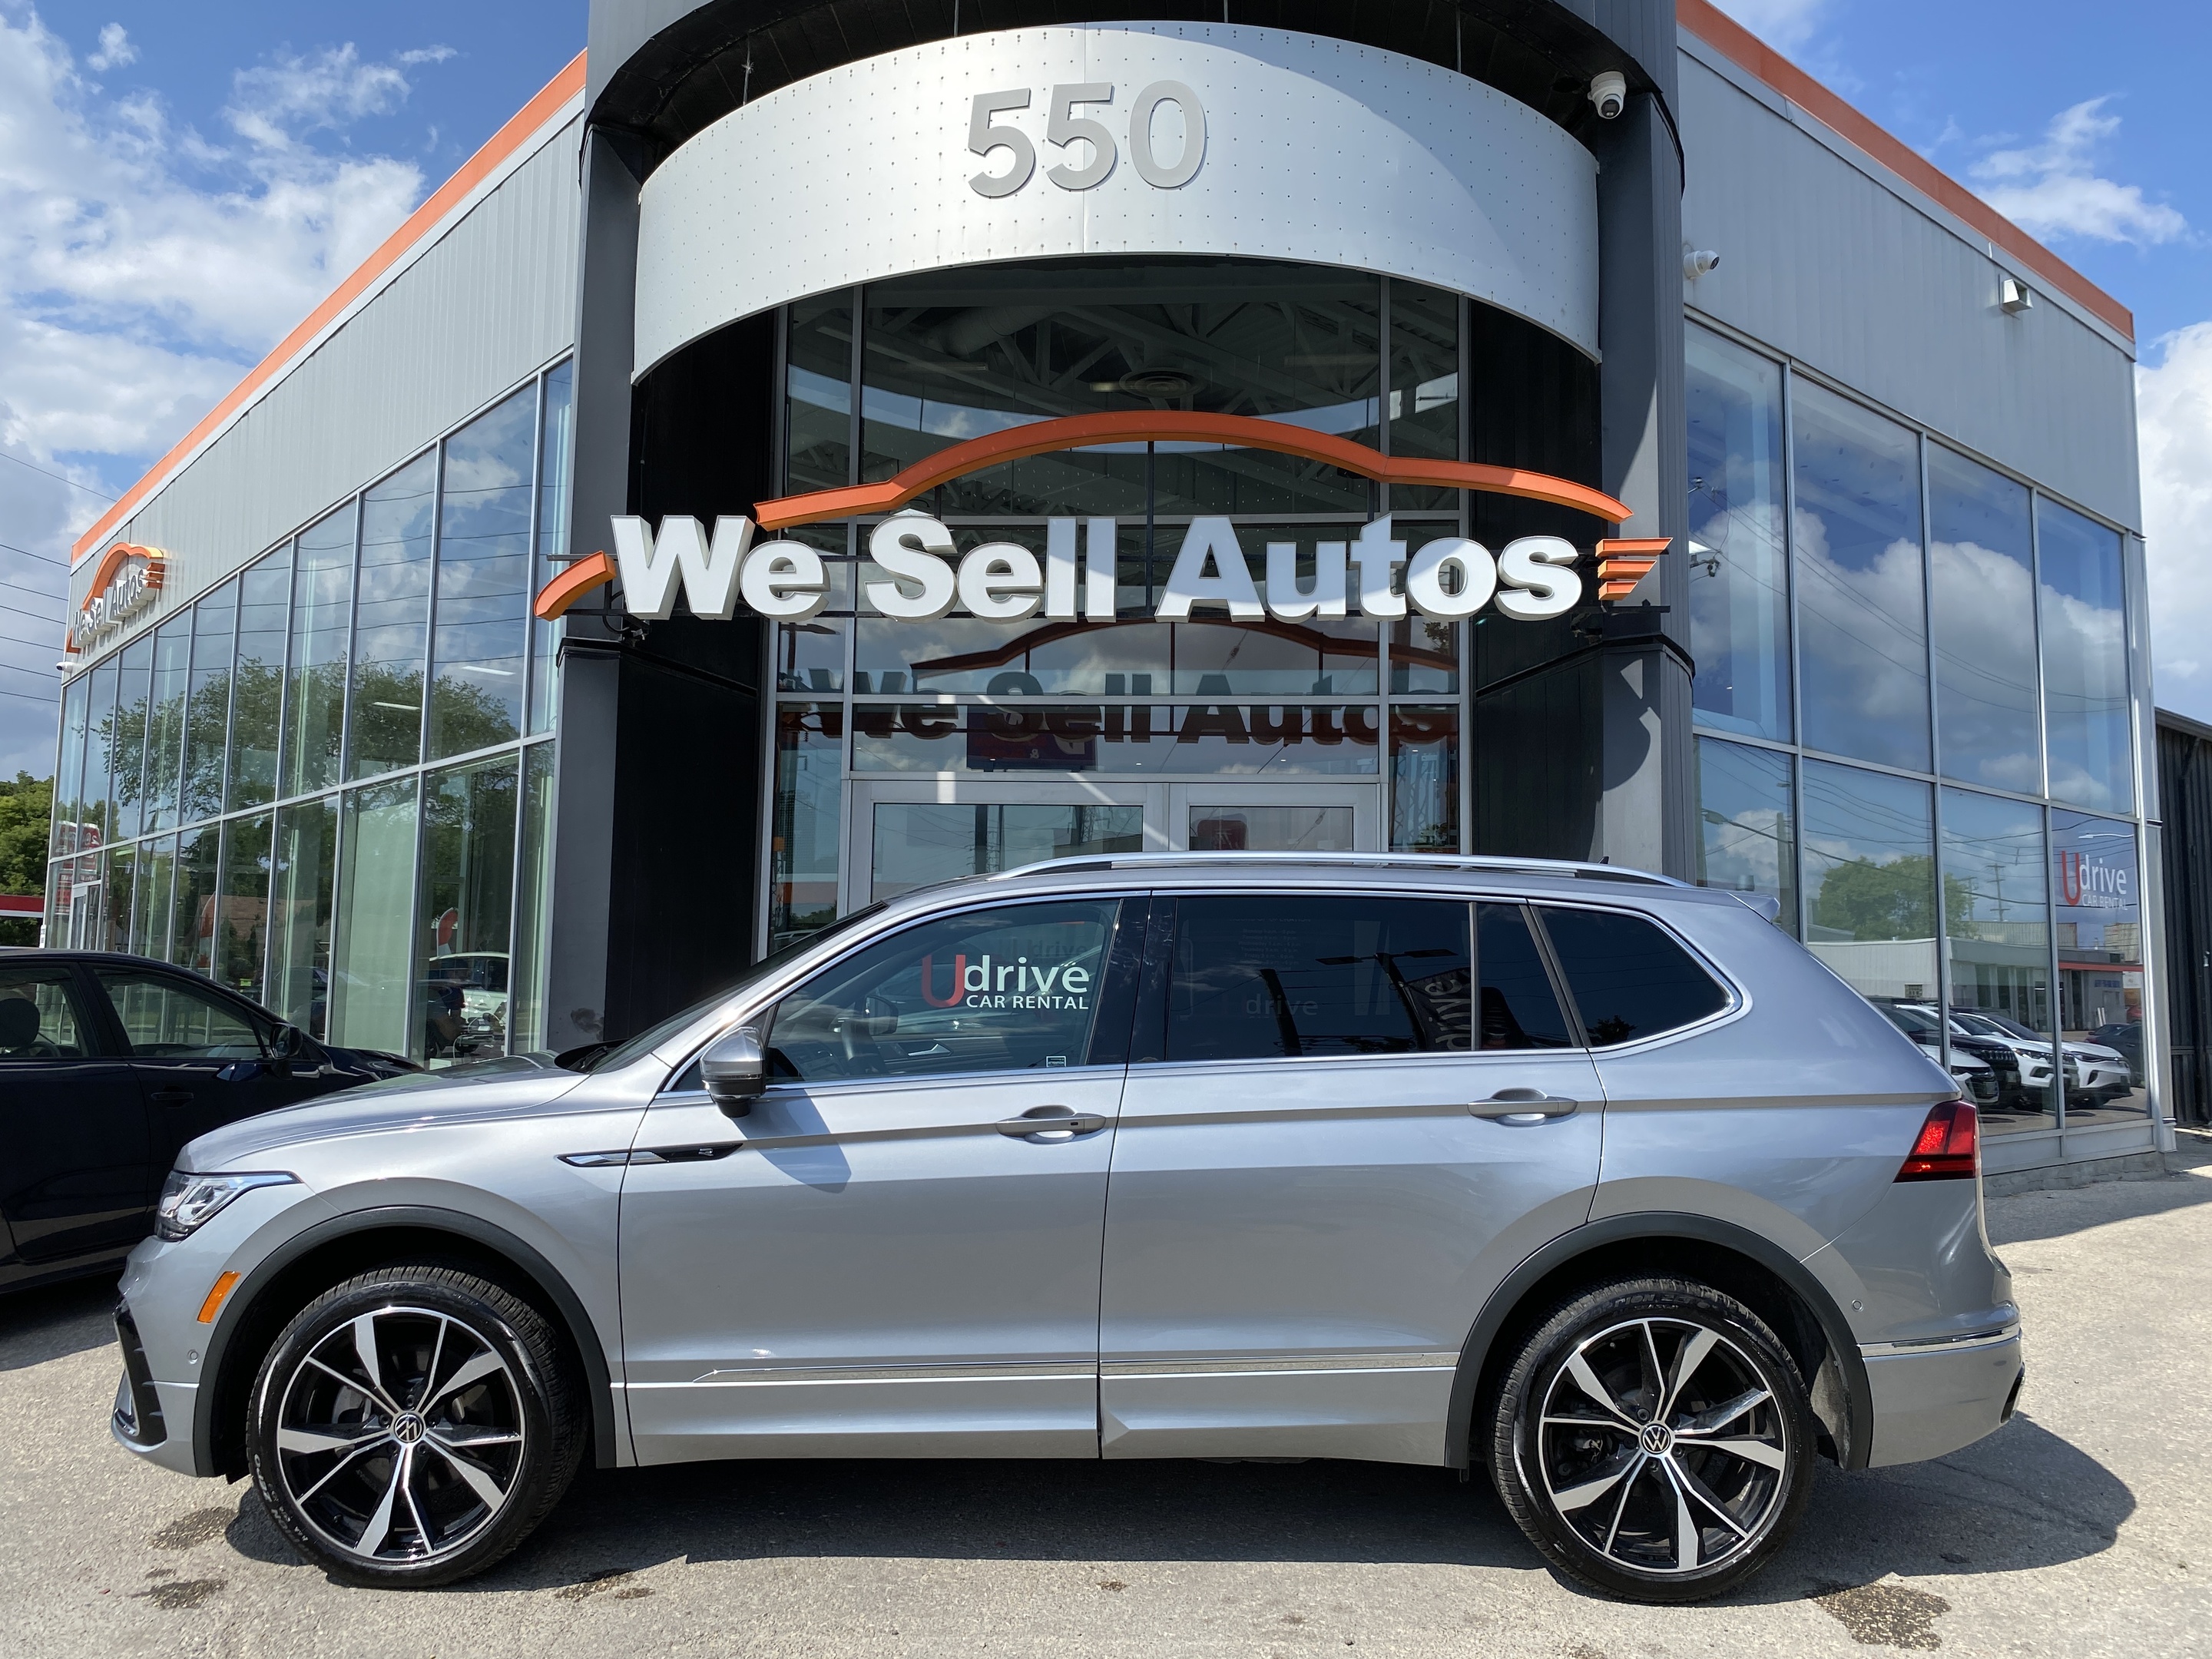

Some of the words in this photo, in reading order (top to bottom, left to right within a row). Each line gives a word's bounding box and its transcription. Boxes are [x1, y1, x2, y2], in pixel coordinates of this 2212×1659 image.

[968, 80, 1207, 198] 550
[611, 514, 830, 621] We
[865, 511, 1116, 623] Sell
[1154, 512, 1582, 623] Autos
[2061, 850, 2127, 906] Udrive
[2081, 894, 2098, 908] CAR
[2099, 896, 2128, 911] RENTAL
[922, 954, 1090, 1008] Udrive
[966, 995, 1005, 1008] CAR
[1012, 995, 1090, 1010] RENTAL
